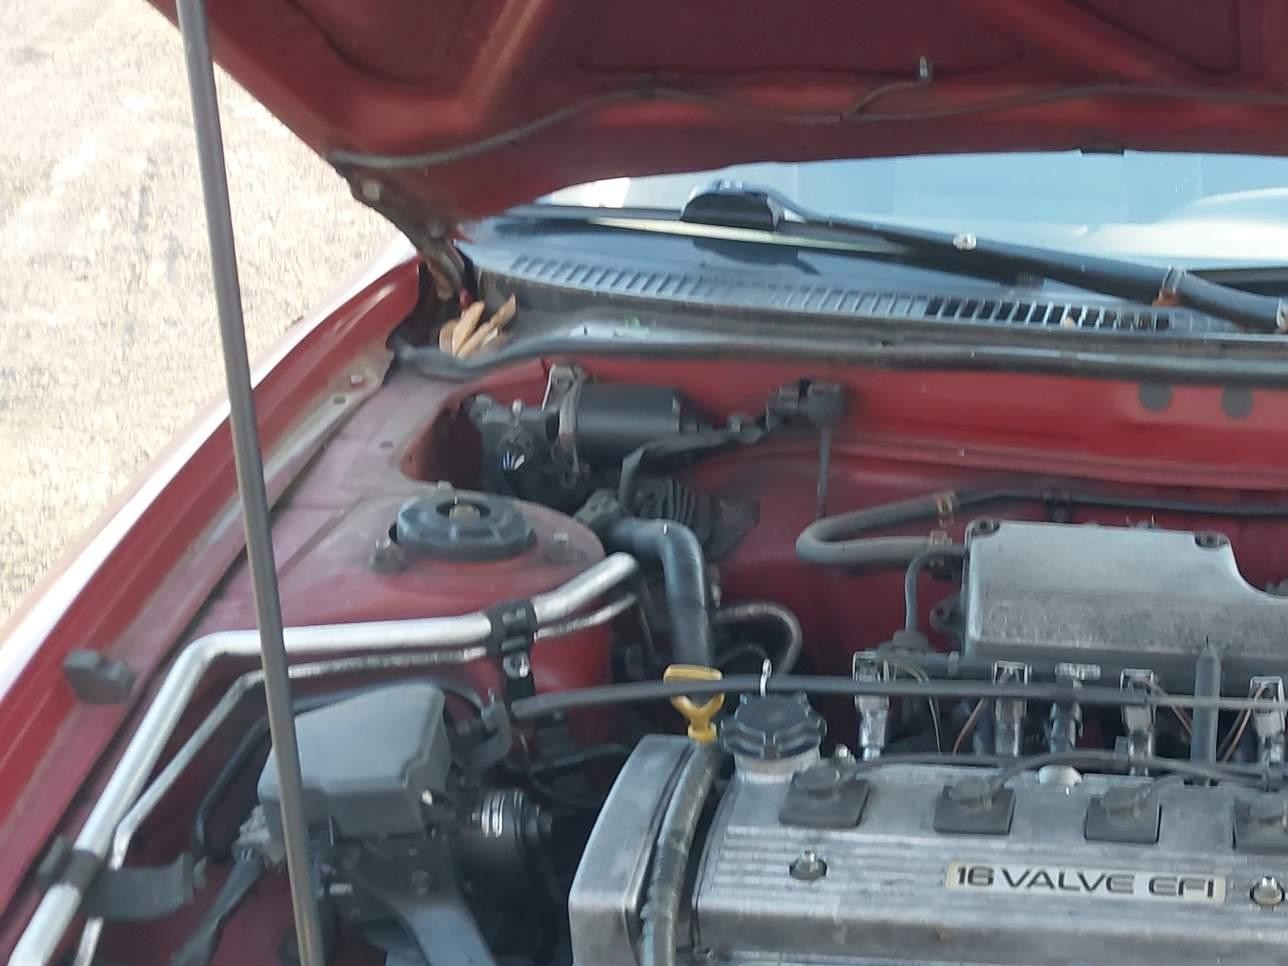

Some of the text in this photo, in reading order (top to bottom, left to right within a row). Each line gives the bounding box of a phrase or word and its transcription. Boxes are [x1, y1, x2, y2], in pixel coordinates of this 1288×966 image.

[956, 865, 1215, 898] 16 VALVE EFI
